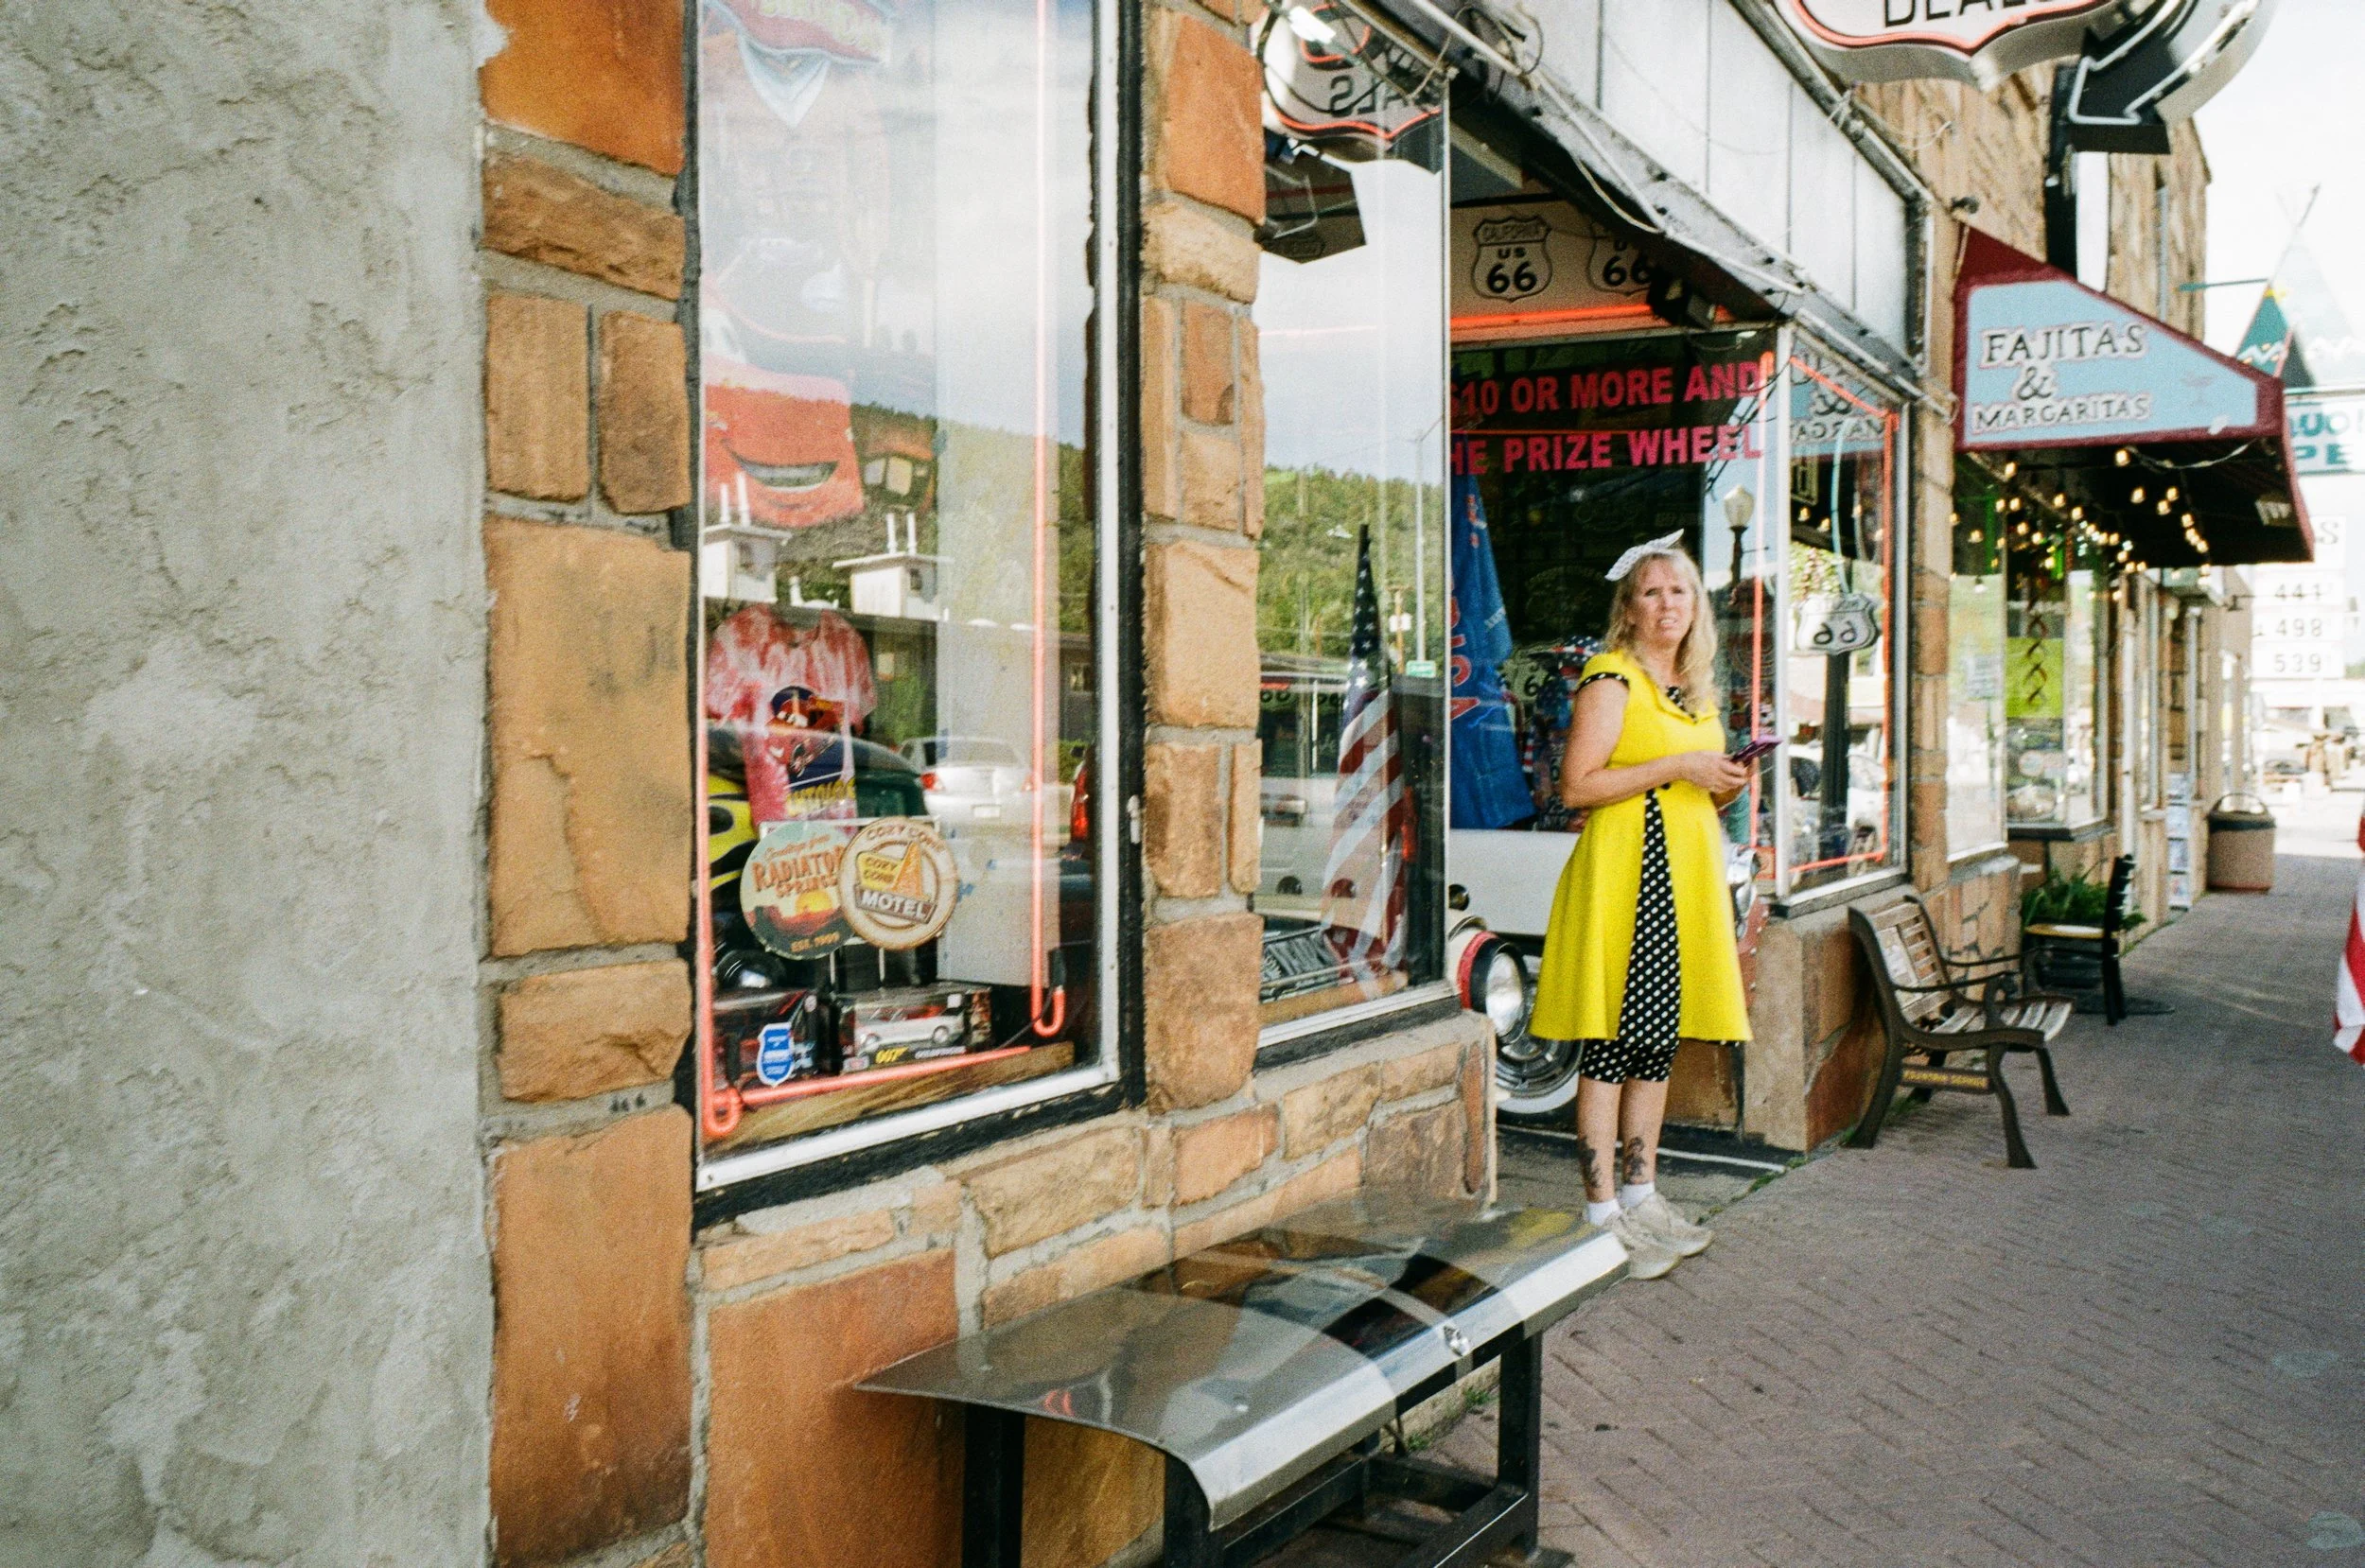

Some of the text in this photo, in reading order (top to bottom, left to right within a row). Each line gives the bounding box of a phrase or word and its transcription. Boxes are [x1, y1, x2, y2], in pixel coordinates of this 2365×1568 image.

[1487, 261, 1537, 293] 66
[1986, 324, 2144, 362] FAJITAS
[1511, 376, 1559, 413] OR
[1570, 367, 1673, 409] MORE
[1684, 361, 1761, 402] AND
[2016, 366, 2052, 401] &
[1974, 397, 2149, 427] MARGARITAS
[1503, 431, 1613, 473] PRIZE
[1628, 425, 1763, 466] WHEEL
[861, 890, 927, 919] MOTEL
